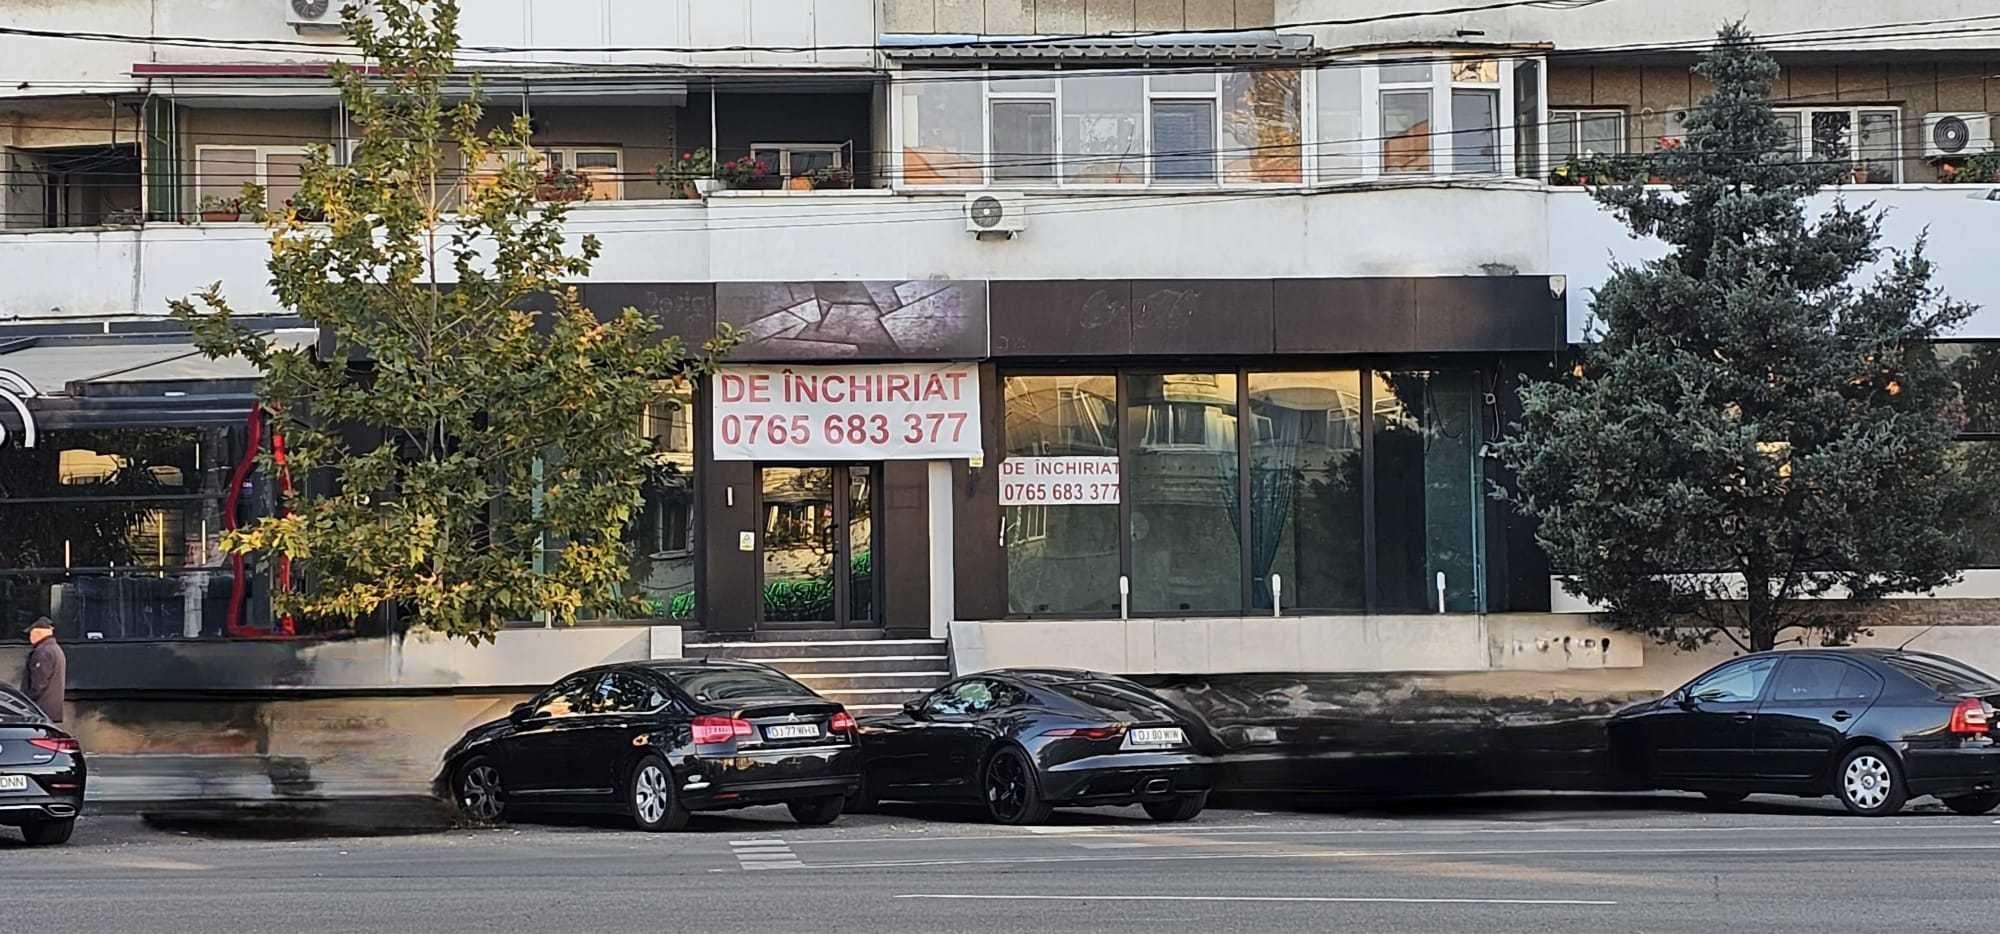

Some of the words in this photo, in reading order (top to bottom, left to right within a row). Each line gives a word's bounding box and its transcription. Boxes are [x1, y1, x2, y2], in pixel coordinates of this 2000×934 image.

[721, 374, 770, 402] DE
[782, 368, 968, 402] ÎNCHIRIAT
[721, 414, 810, 445] 0765
[824, 414, 890, 445] 683
[904, 413, 968, 443] 377
[1003, 463, 1025, 475] DE
[1036, 459, 1119, 475] ÎNCHIRIAT
[1005, 484, 1046, 500] 0765
[1053, 484, 1083, 500] 683
[1090, 484, 1120, 500] 377
[785, 726, 796, 737] 77
